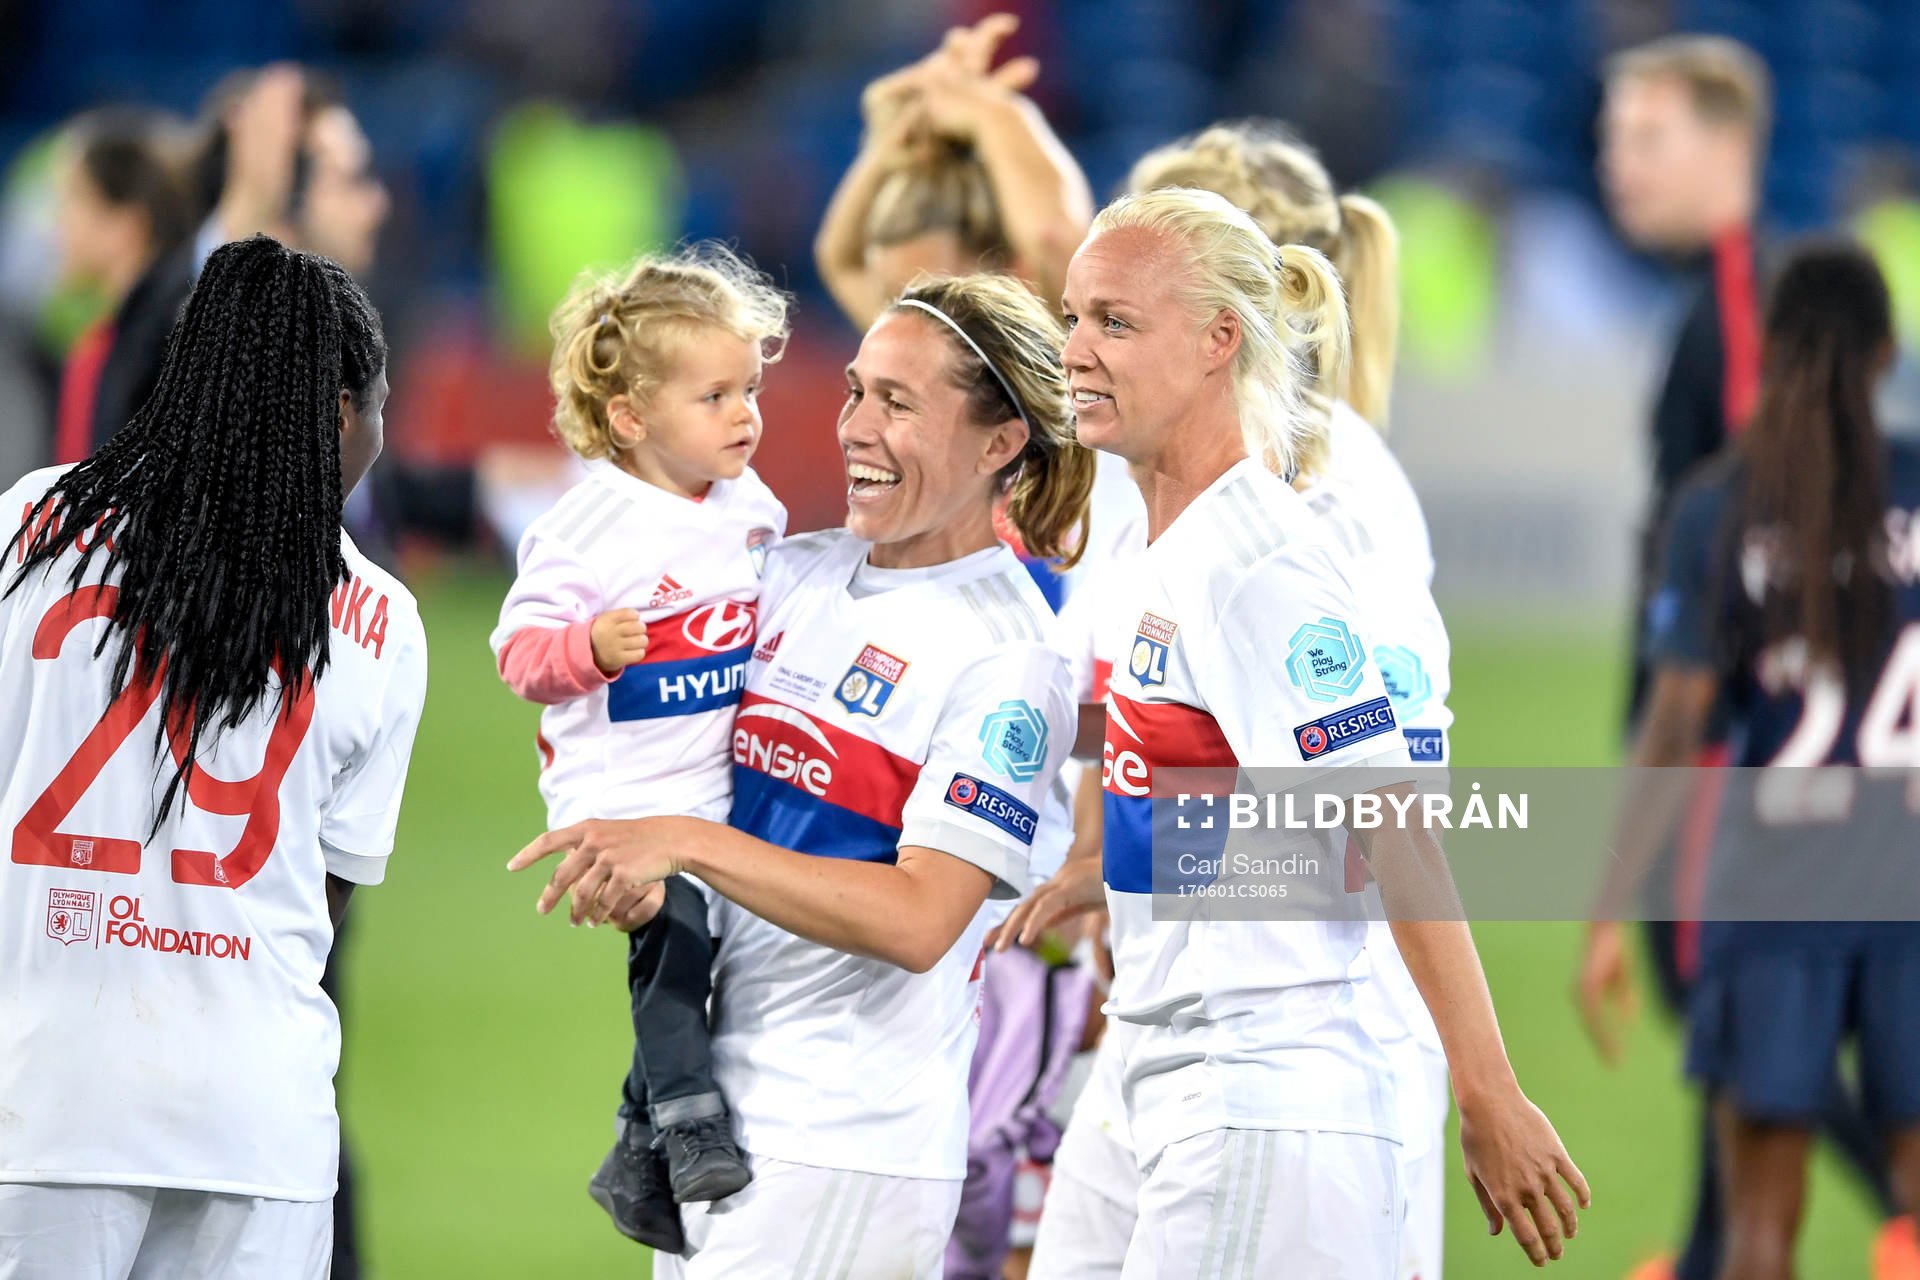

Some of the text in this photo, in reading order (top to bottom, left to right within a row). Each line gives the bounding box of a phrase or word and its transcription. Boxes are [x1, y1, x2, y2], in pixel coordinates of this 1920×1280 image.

[1138, 622, 1172, 643] LYONNAIS
[1142, 613, 1176, 633] OLYMPIQUE
[1307, 648, 1323, 658] We
[1312, 656, 1333, 668] Play
[1315, 661, 1347, 677] Strong
[1008, 720, 1022, 734] We
[1327, 706, 1393, 741] RESPECT
[11, 584, 316, 889] 29
[1002, 739, 1030, 762] Strong
[976, 791, 1036, 836] RESPECT
[52, 898, 91, 909] LYONNAIS
[53, 891, 91, 902] OLYMPIQUE
[108, 895, 145, 922] OL
[105, 920, 251, 961] FONDATION
